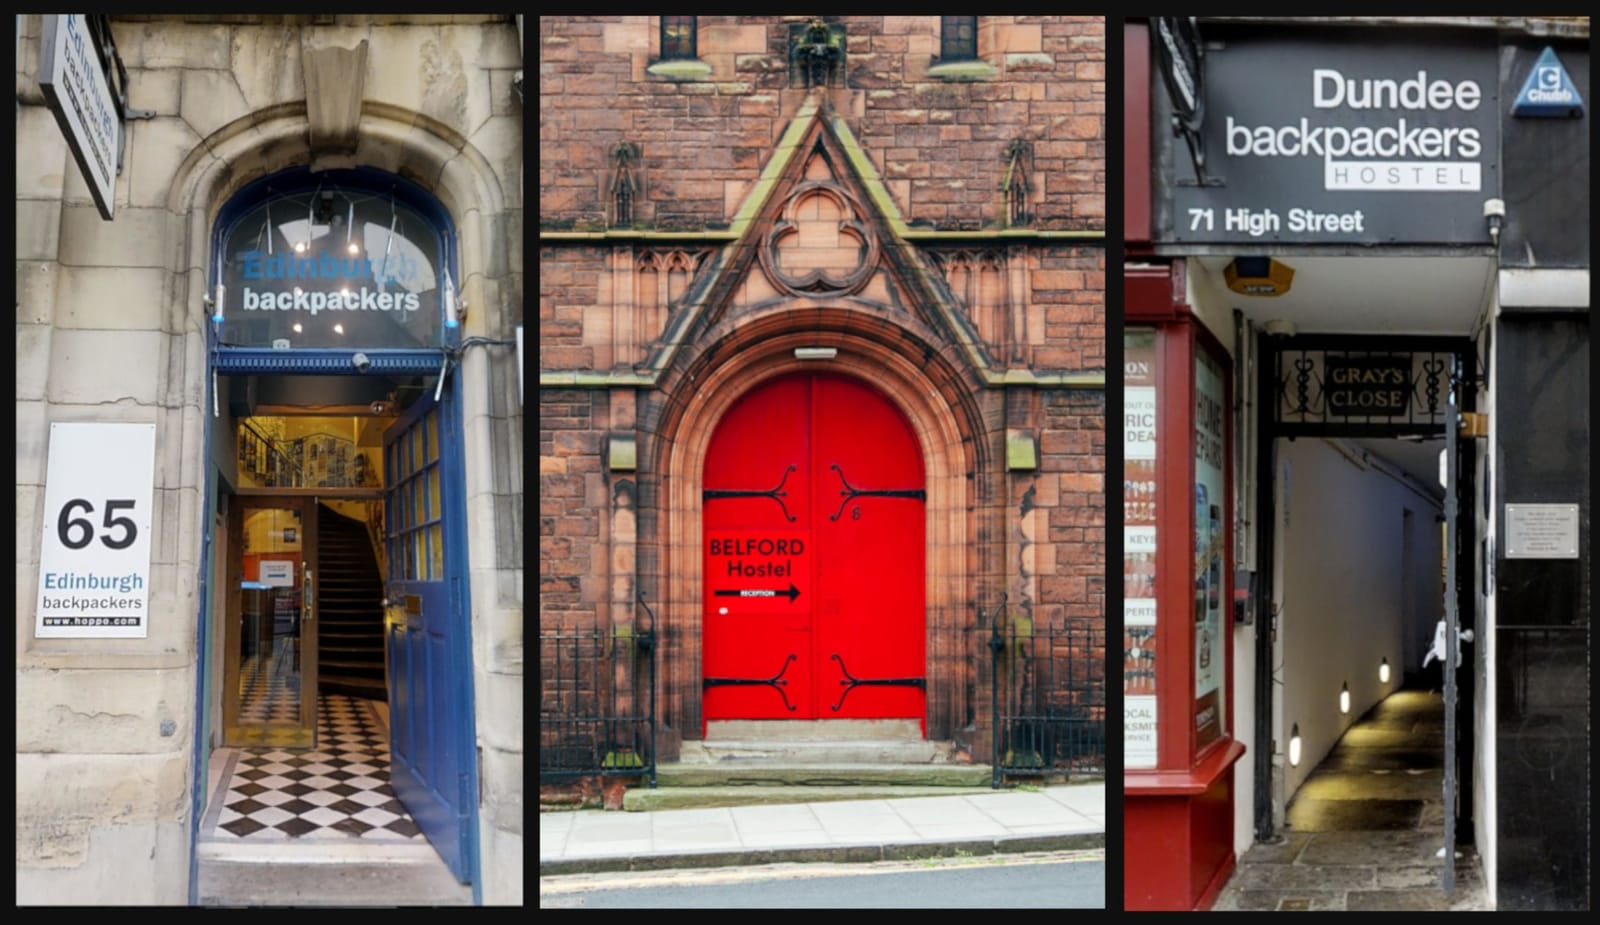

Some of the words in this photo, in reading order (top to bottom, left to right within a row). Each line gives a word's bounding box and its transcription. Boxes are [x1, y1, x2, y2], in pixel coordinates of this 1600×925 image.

[1313, 69, 1481, 109] Dundee
[1527, 88, 1572, 102] Chubb
[1226, 117, 1481, 163] backpackers
[1334, 168, 1471, 184] HOSTEL
[1188, 208, 1214, 231] 71
[1225, 208, 1279, 235] High
[1288, 209, 1364, 232] Street
[242, 250, 417, 287] Edinburgh
[243, 287, 420, 315] backpackers
[1332, 367, 1404, 384] GRAY'S
[1331, 390, 1402, 407] CLOSE
[57, 498, 137, 550] 65
[709, 539, 804, 556] BELFORD
[727, 560, 791, 577] Hostel
[45, 572, 143, 593] Edinburgh
[740, 589, 775, 597] RECEPTION
[43, 595, 142, 612] backpackers
[44, 617, 138, 626] www.hoppo.com
